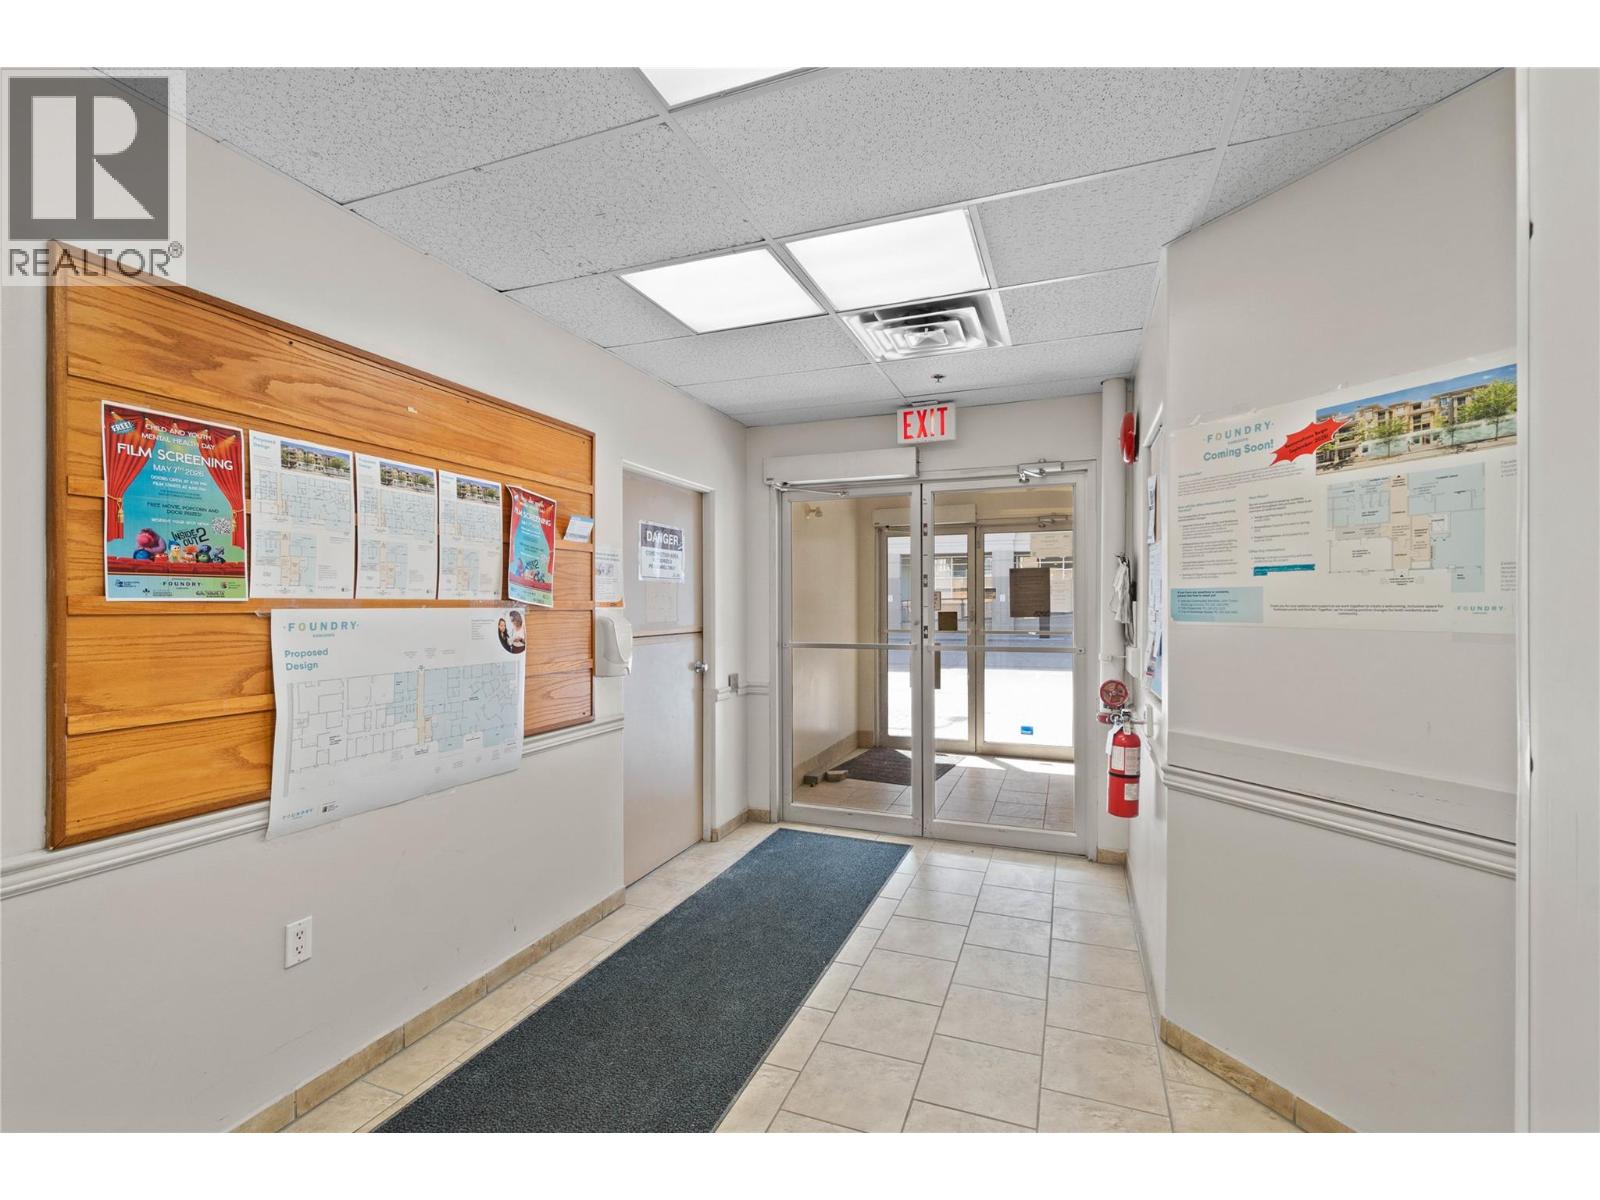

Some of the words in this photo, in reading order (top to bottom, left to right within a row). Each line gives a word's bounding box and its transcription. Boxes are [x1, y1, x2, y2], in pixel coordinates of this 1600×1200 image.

[111, 421, 132, 432] FREE!
[902, 406, 948, 440] EXIT
[145, 423, 167, 433] CHILD
[169, 427, 186, 437] AND
[188, 431, 212, 441] YOUTH
[1206, 419, 1272, 444] FOUNDRY
[141, 432, 170, 443] MENTAL
[172, 438, 199, 448] HEALTH
[201, 443, 216, 451] DAY
[117, 442, 152, 459] FILM
[157, 448, 234, 471] SCREENING
[1202, 445, 1242, 462] Coming
[1243, 438, 1275, 454] Soon!
[153, 463, 172, 473] MAY
[171, 529, 198, 542] INSIDE
[196, 527, 210, 543] 2
[183, 536, 199, 547] OUT
[646, 530, 679, 546] DANGER
[287, 621, 358, 633] FOUNDRY
[284, 648, 329, 659] Proposed
[285, 661, 319, 672] Design
